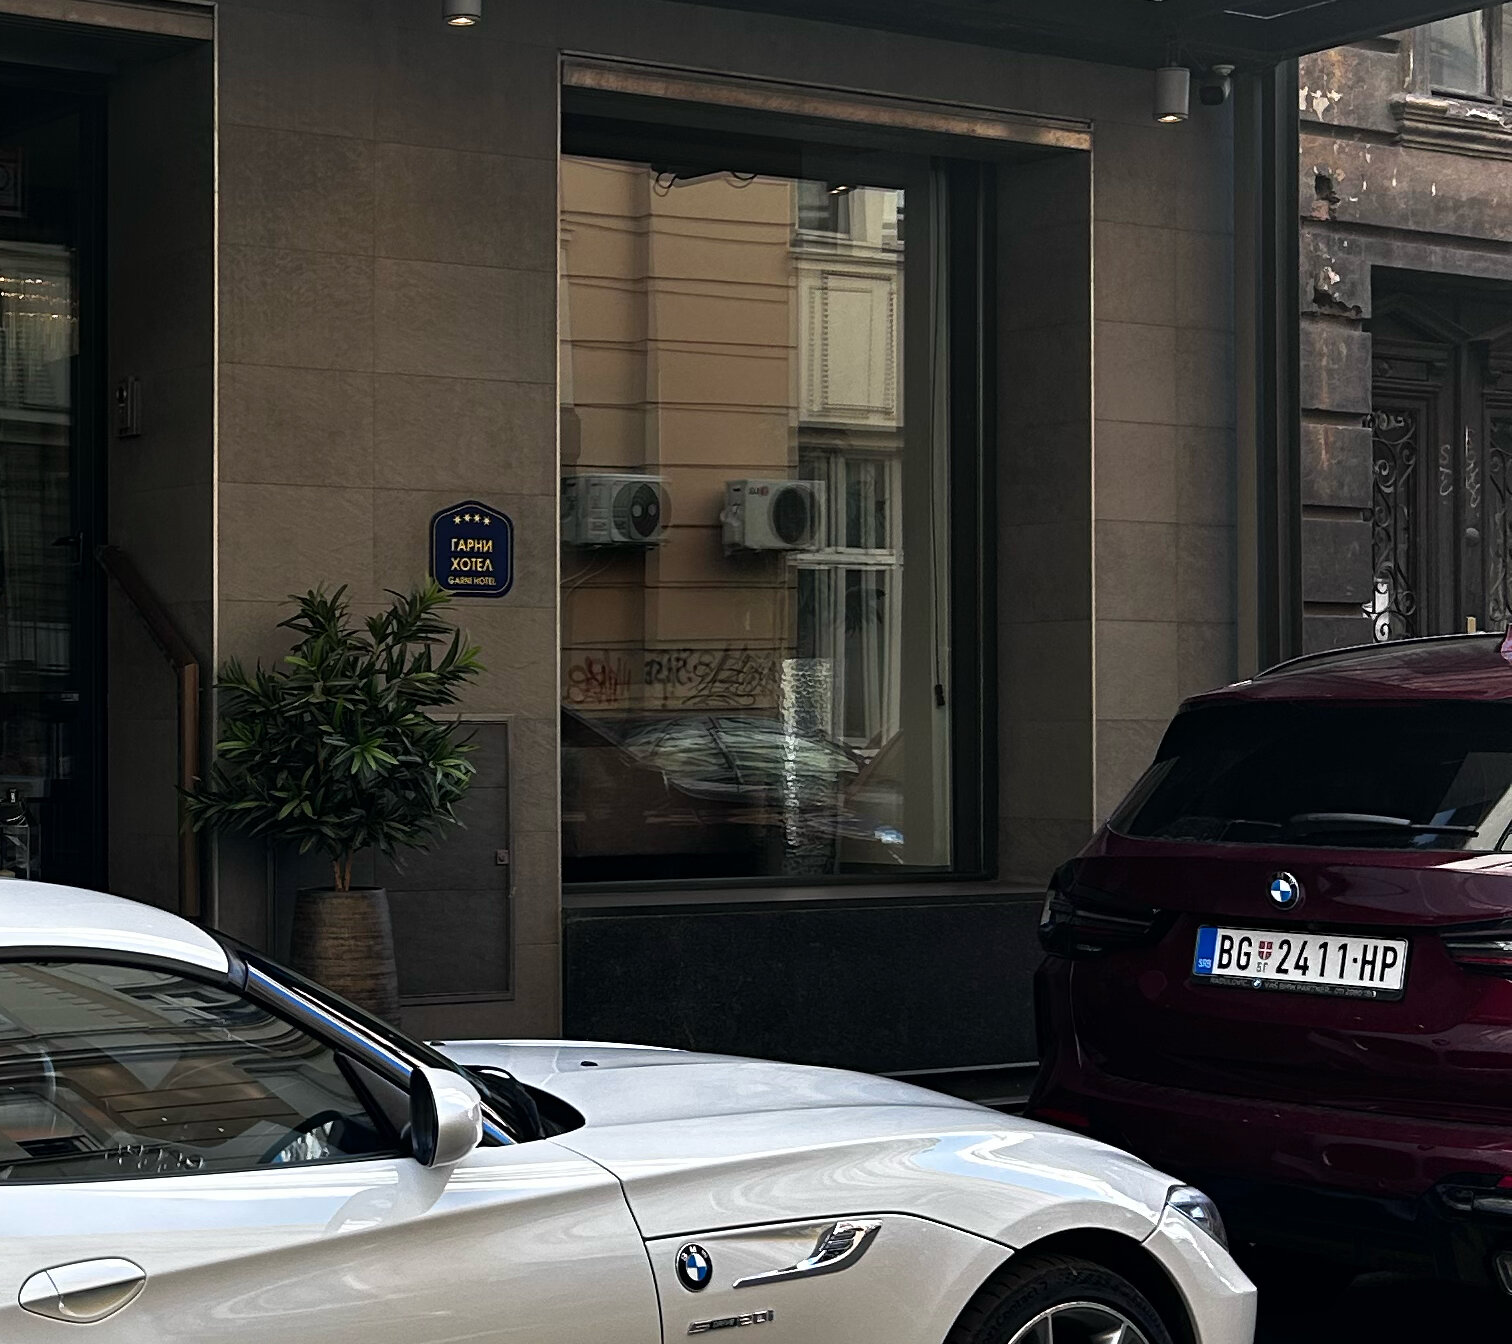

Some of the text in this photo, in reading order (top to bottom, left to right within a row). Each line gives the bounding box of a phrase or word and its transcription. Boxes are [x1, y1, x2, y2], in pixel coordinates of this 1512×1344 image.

[451, 538, 493, 553] ГАРНИ
[450, 557, 494, 572] ХОТЕЛ
[1216, 934, 1253, 971] BG
